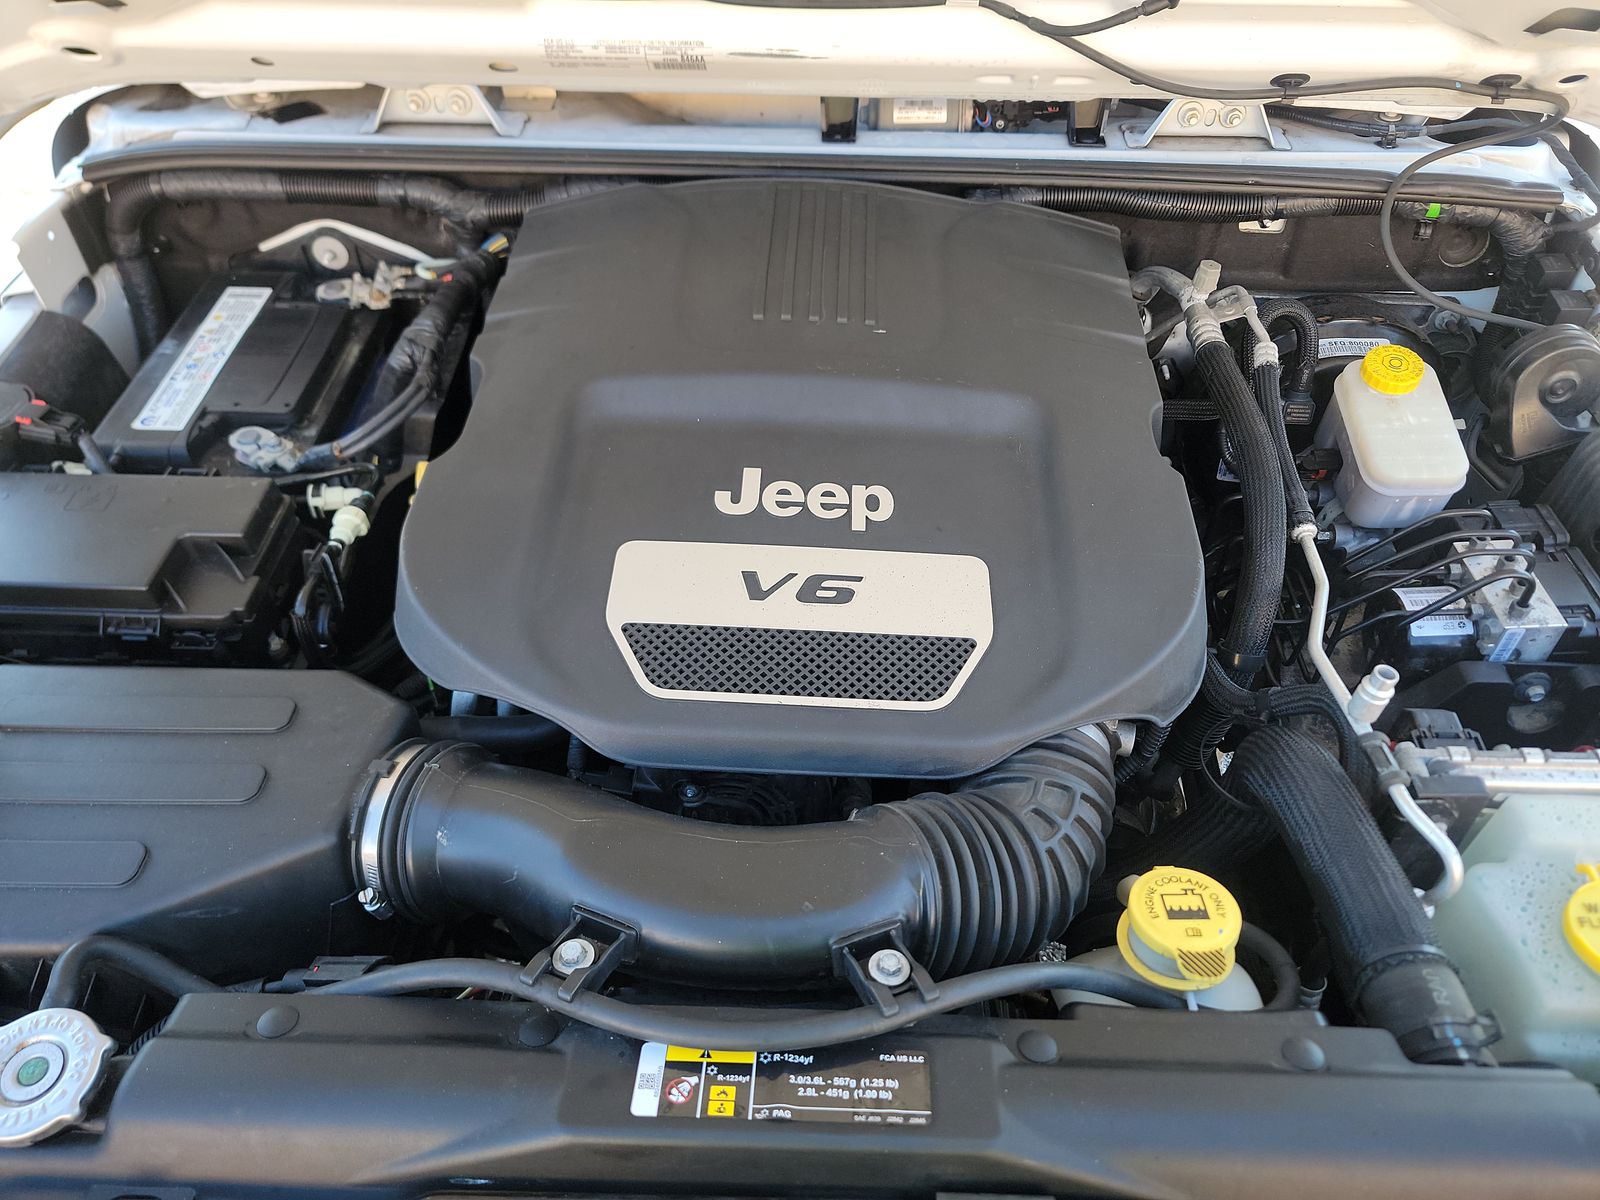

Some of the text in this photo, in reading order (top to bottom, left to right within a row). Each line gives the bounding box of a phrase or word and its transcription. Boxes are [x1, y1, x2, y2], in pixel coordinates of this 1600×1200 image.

[714, 467, 895, 532] Jeep
[741, 570, 864, 605] V6
[1145, 875, 1226, 919] ENGINE COOLANT ONLY
[773, 1053, 814, 1065] R-1234yf
[717, 1075, 750, 1083] R-1234yf
[833, 1077, 857, 1088] 567g
[861, 1078, 885, 1088] (1.25
[886, 1079, 900, 1089] lb)
[826, 1088, 850, 1099] 451g
[879, 1090, 893, 1100] lb)
[773, 1110, 792, 1119] PAG
